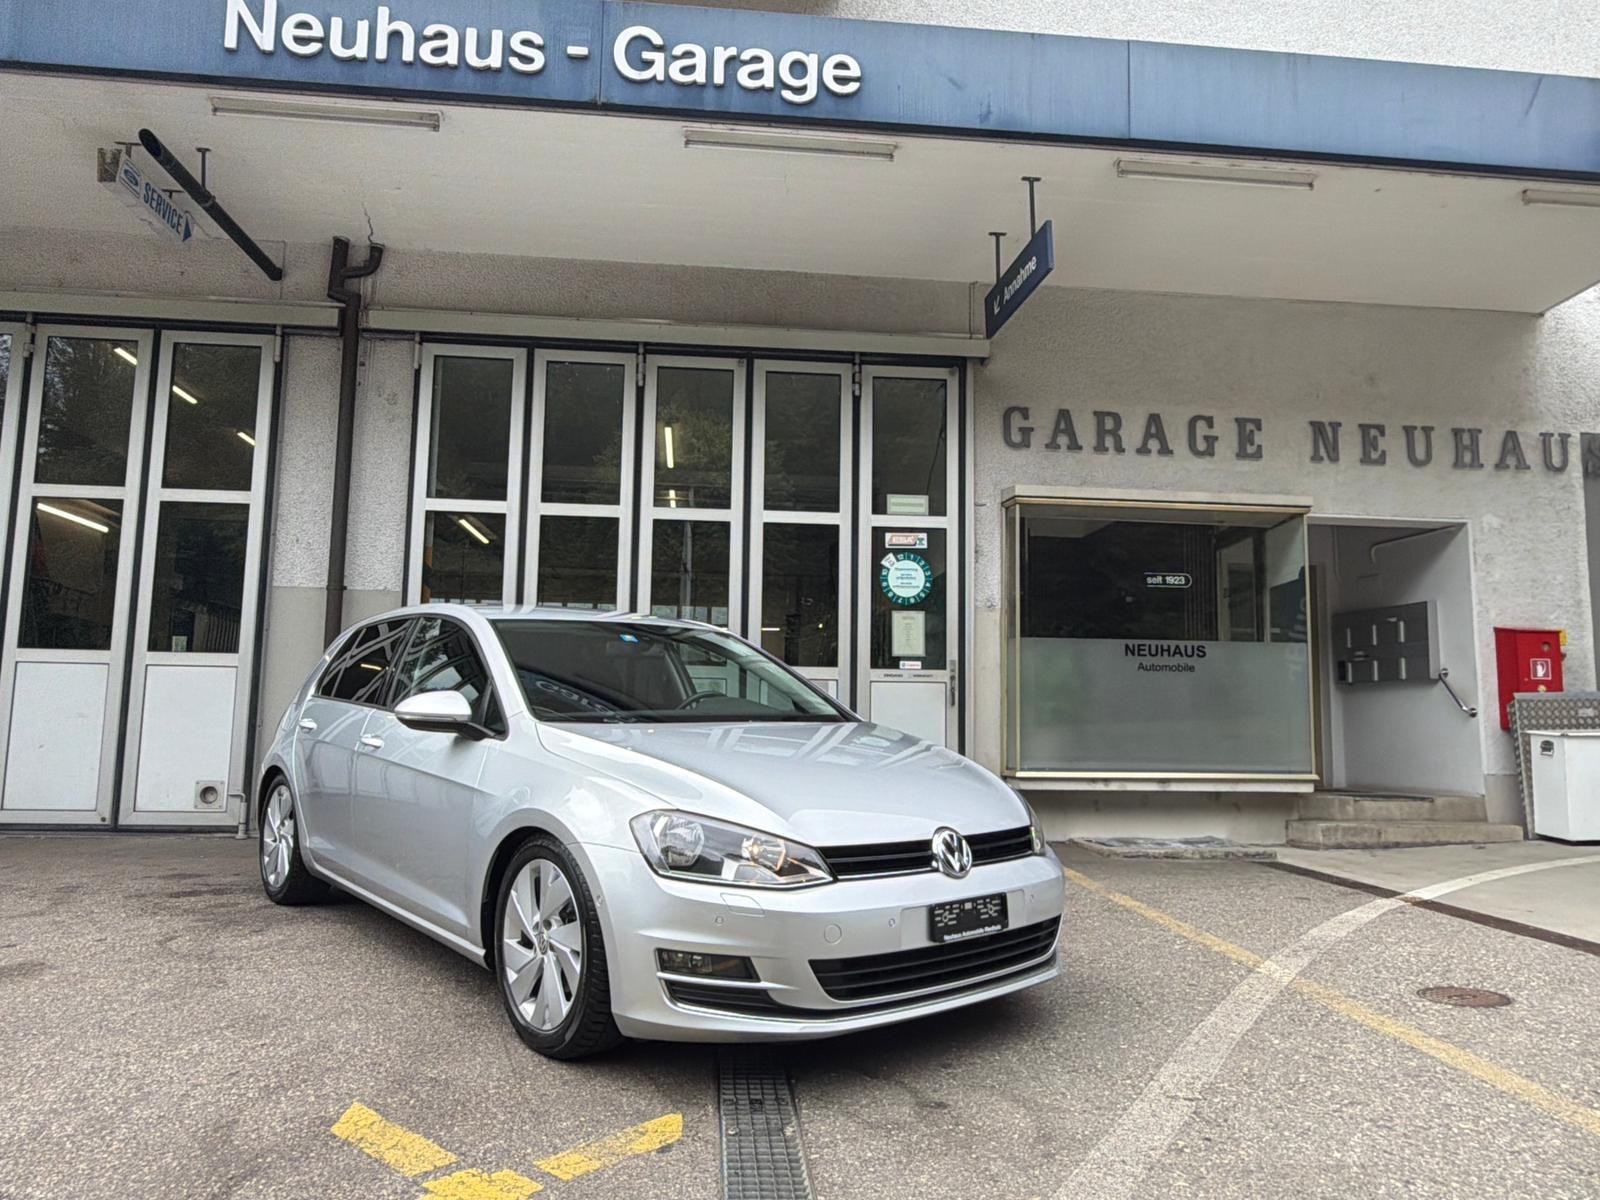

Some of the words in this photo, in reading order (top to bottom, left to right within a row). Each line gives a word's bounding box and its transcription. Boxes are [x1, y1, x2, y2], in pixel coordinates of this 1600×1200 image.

[224, 0, 546, 73] Neuhaus
[613, 25, 863, 104] Garage
[143, 182, 184, 235] SERVICE
[1003, 255, 1037, 305] Annahme
[1001, 406, 1263, 461] GARAGE
[1146, 576, 1163, 584] seit
[1165, 576, 1185, 585] 1923
[1125, 643, 1207, 658] NEUHAUS
[1137, 662, 1196, 673] Automobile
